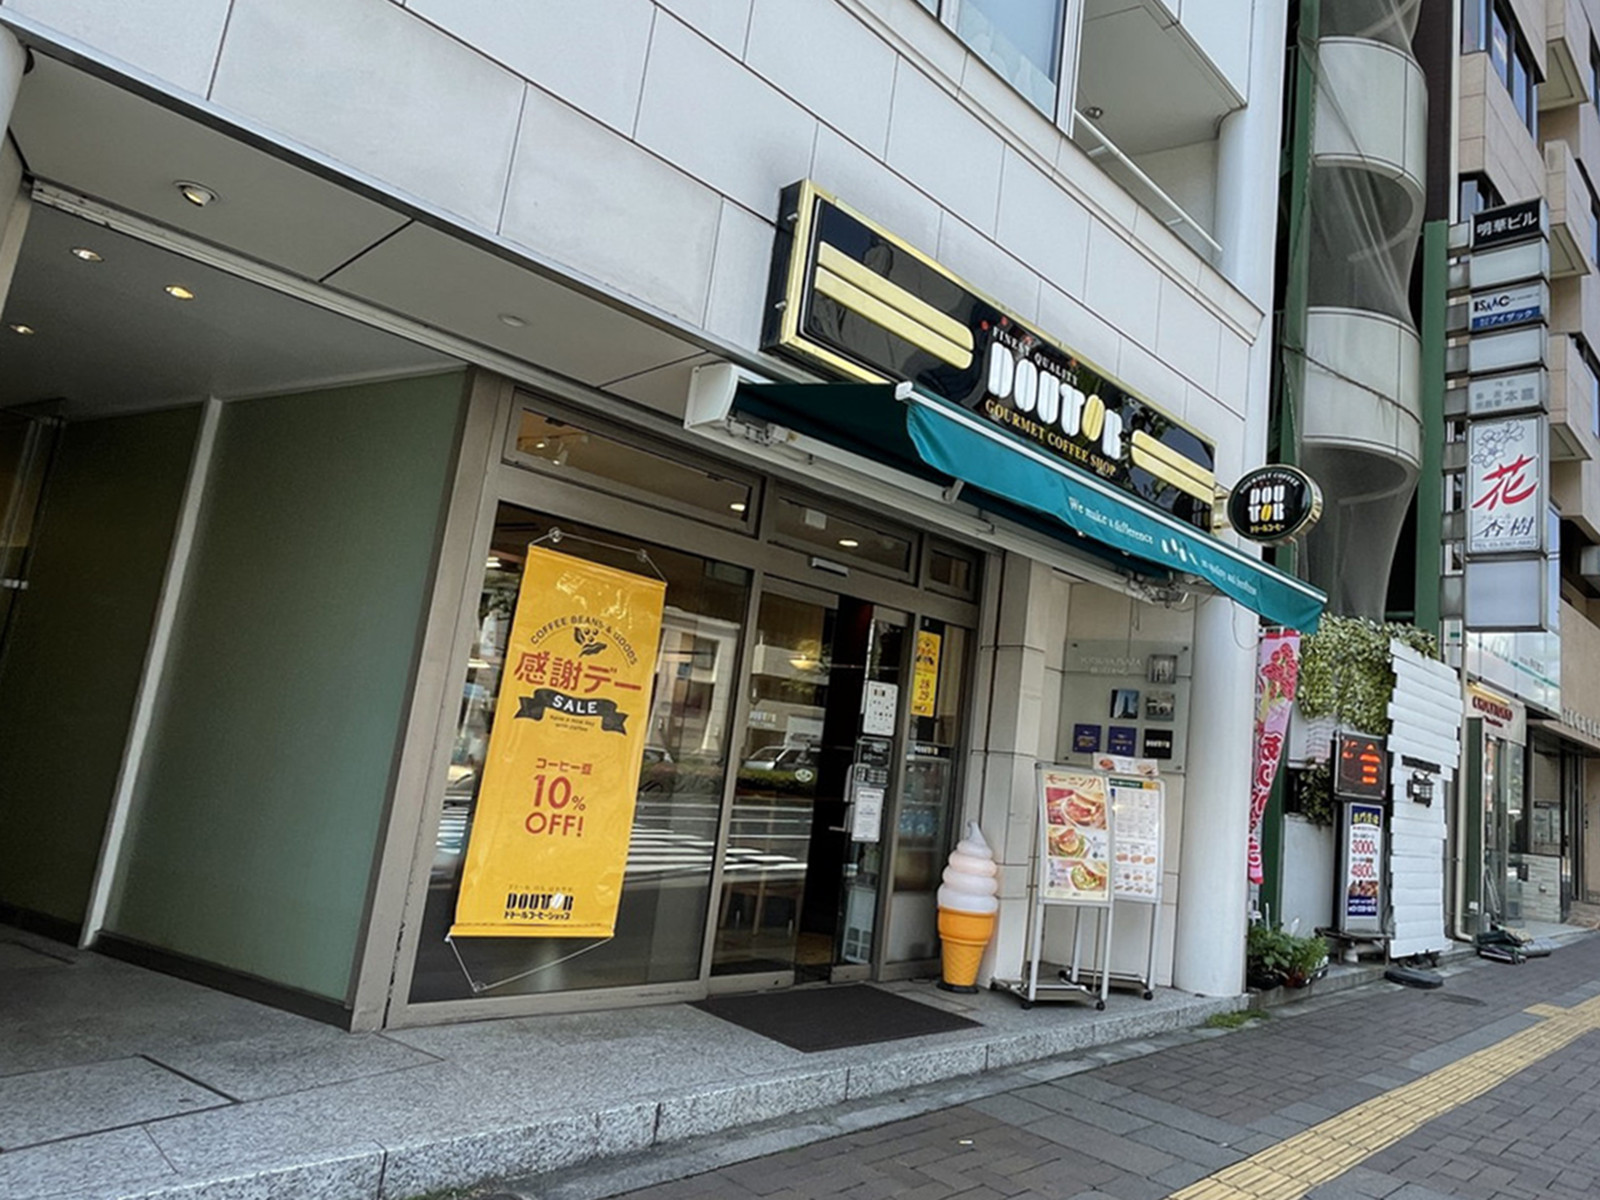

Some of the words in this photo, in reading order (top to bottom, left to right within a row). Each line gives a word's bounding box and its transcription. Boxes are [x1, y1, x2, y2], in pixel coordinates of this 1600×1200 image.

[992, 325, 1031, 357] FINEST
[1033, 351, 1079, 387] QUALITY
[987, 341, 1123, 460] DOUTOR
[985, 399, 1045, 441] GOURMET
[1047, 431, 1089, 460] COFFEE
[1090, 454, 1117, 476] SHOP
[1249, 484, 1285, 505] DOU
[1471, 453, 1538, 511] 花
[1247, 502, 1285, 523] TOR
[530, 616, 568, 645] COFFEE
[570, 615, 604, 630] BEANS
[605, 625, 612, 634] &
[613, 631, 638, 666] GOODS
[514, 650, 642, 693] 感謝デー
[552, 694, 598, 714] SALE
[533, 774, 586, 812] 10%
[1046, 773, 1097, 789] モーニング
[525, 811, 584, 838] OFF!
[506, 892, 574, 911] DOUTOR
